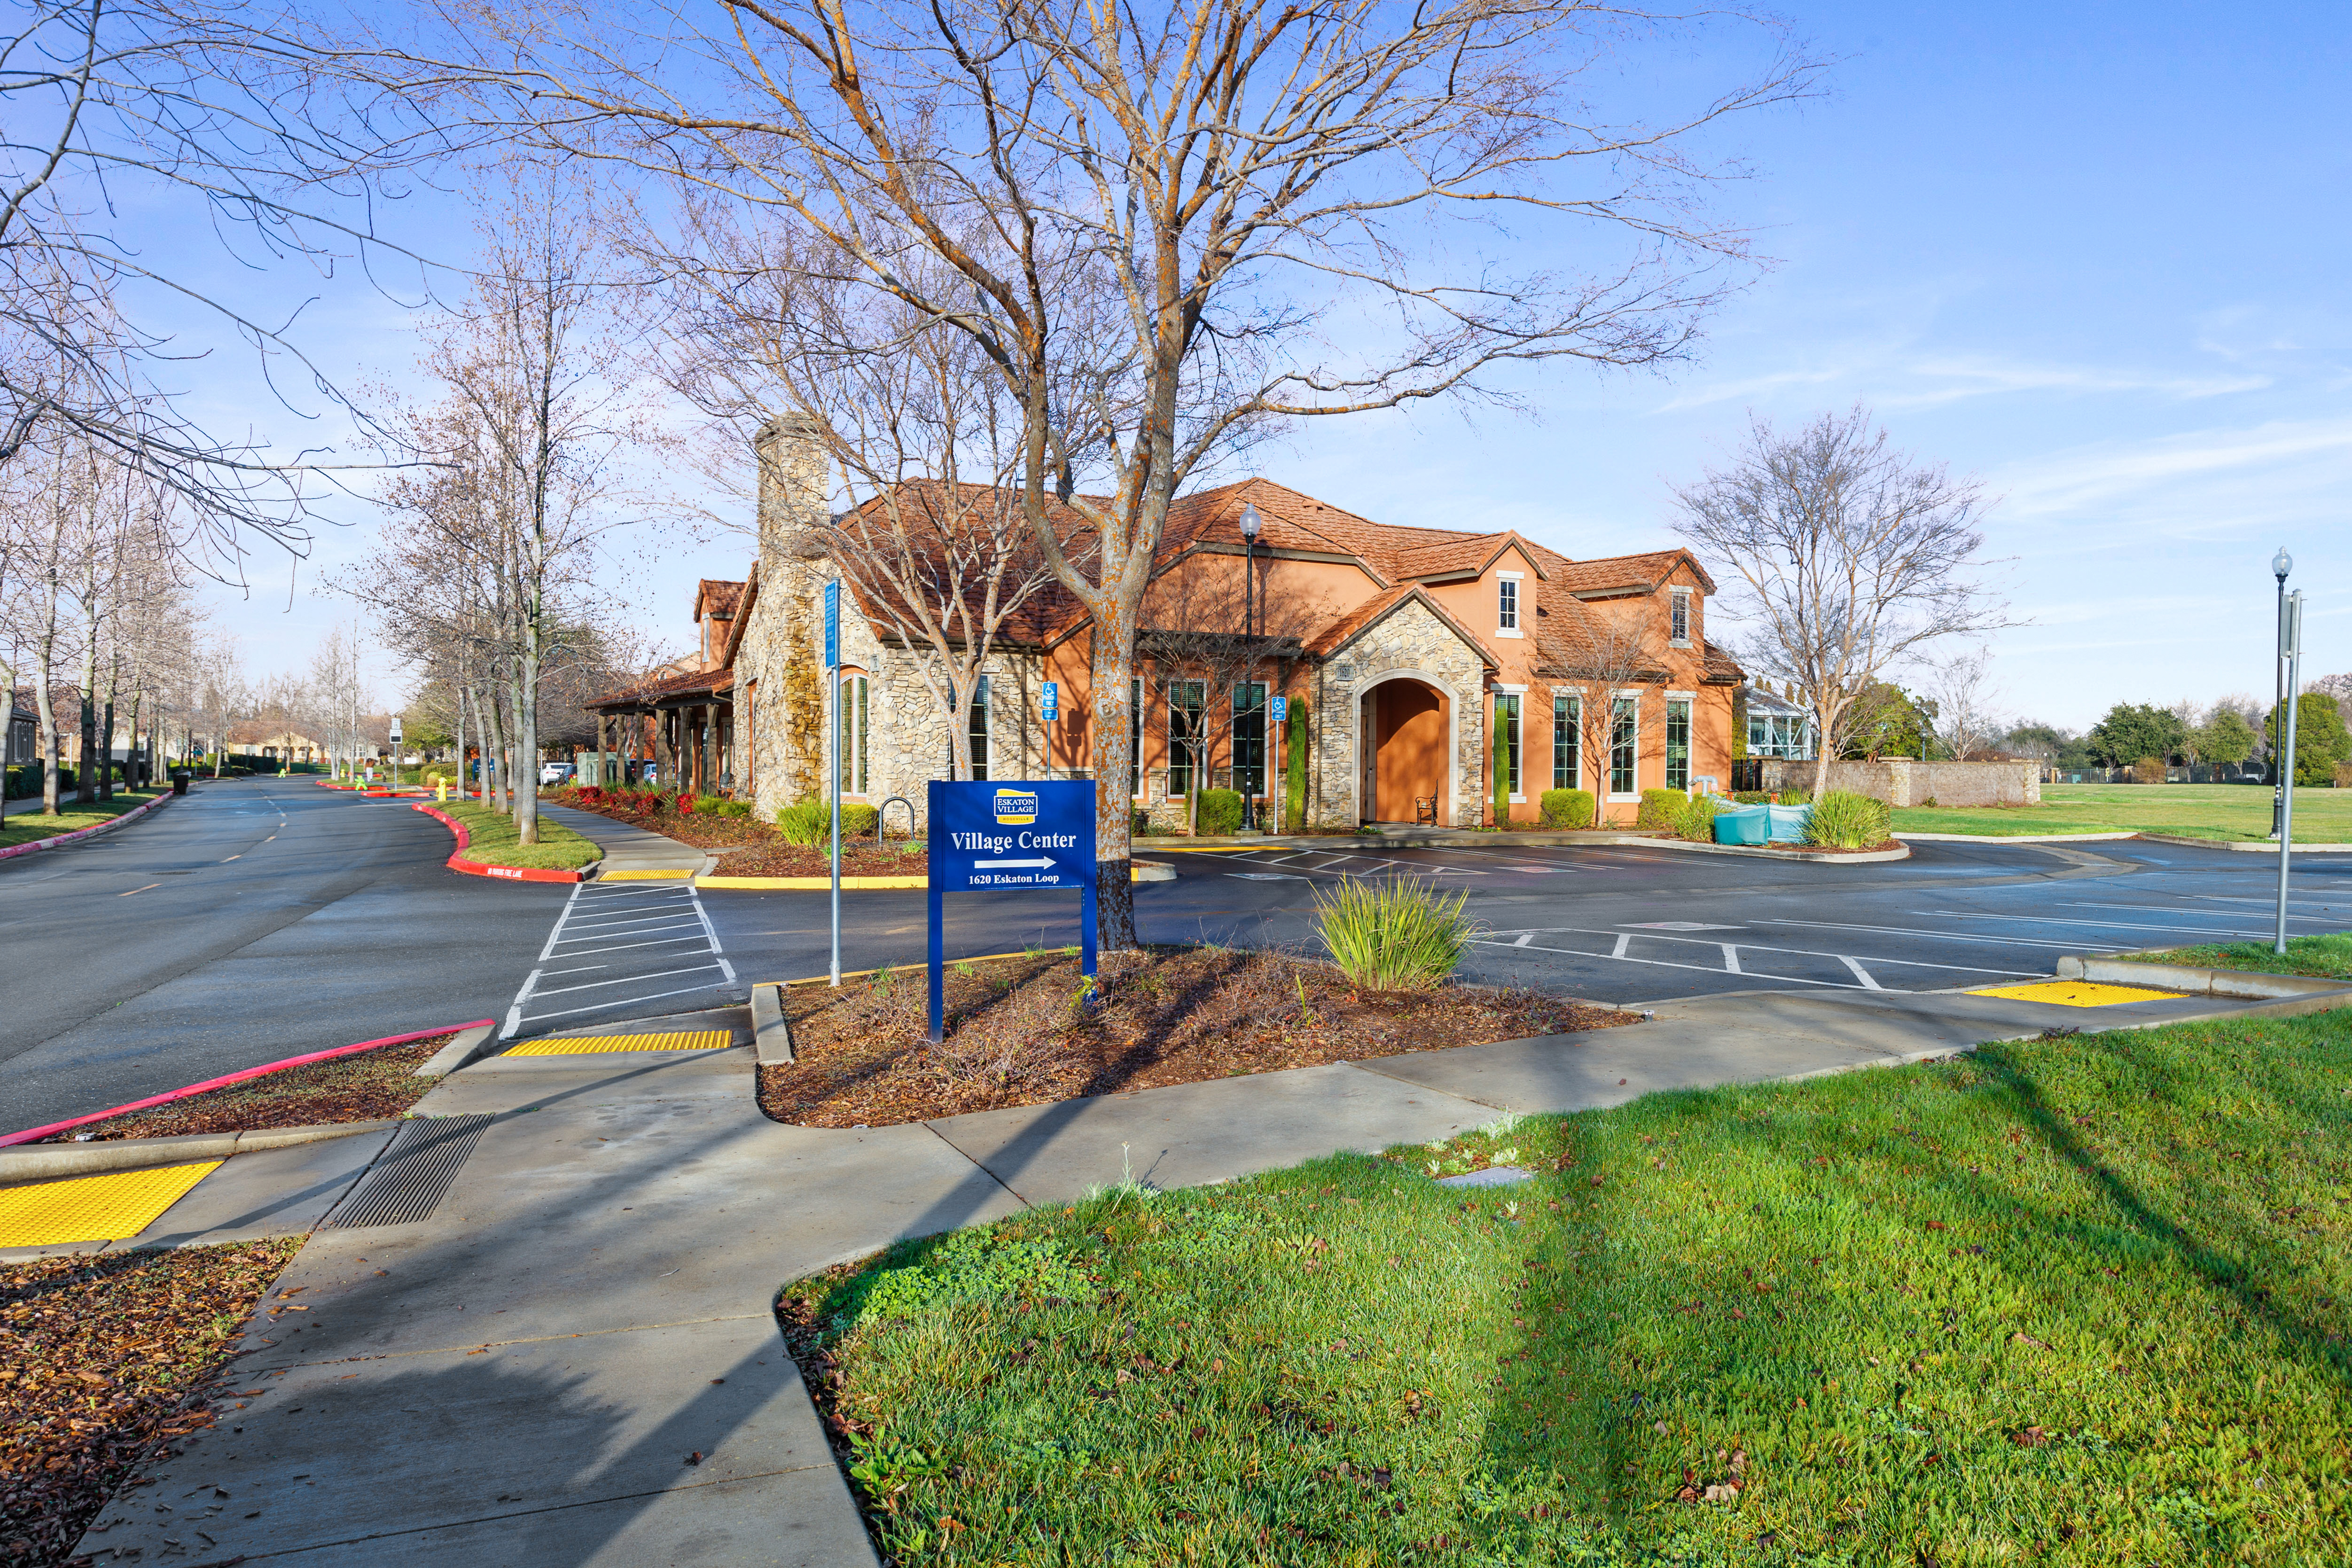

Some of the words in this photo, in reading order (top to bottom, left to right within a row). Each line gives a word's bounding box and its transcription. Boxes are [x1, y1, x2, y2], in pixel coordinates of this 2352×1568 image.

[1340, 668, 1350, 677] 1620
[951, 832, 1012, 854] Village
[1018, 831, 1077, 849] Center
[969, 875, 991, 884] 1620
[994, 874, 1032, 883] Eskaton
[1035, 874, 1060, 884] Loop
